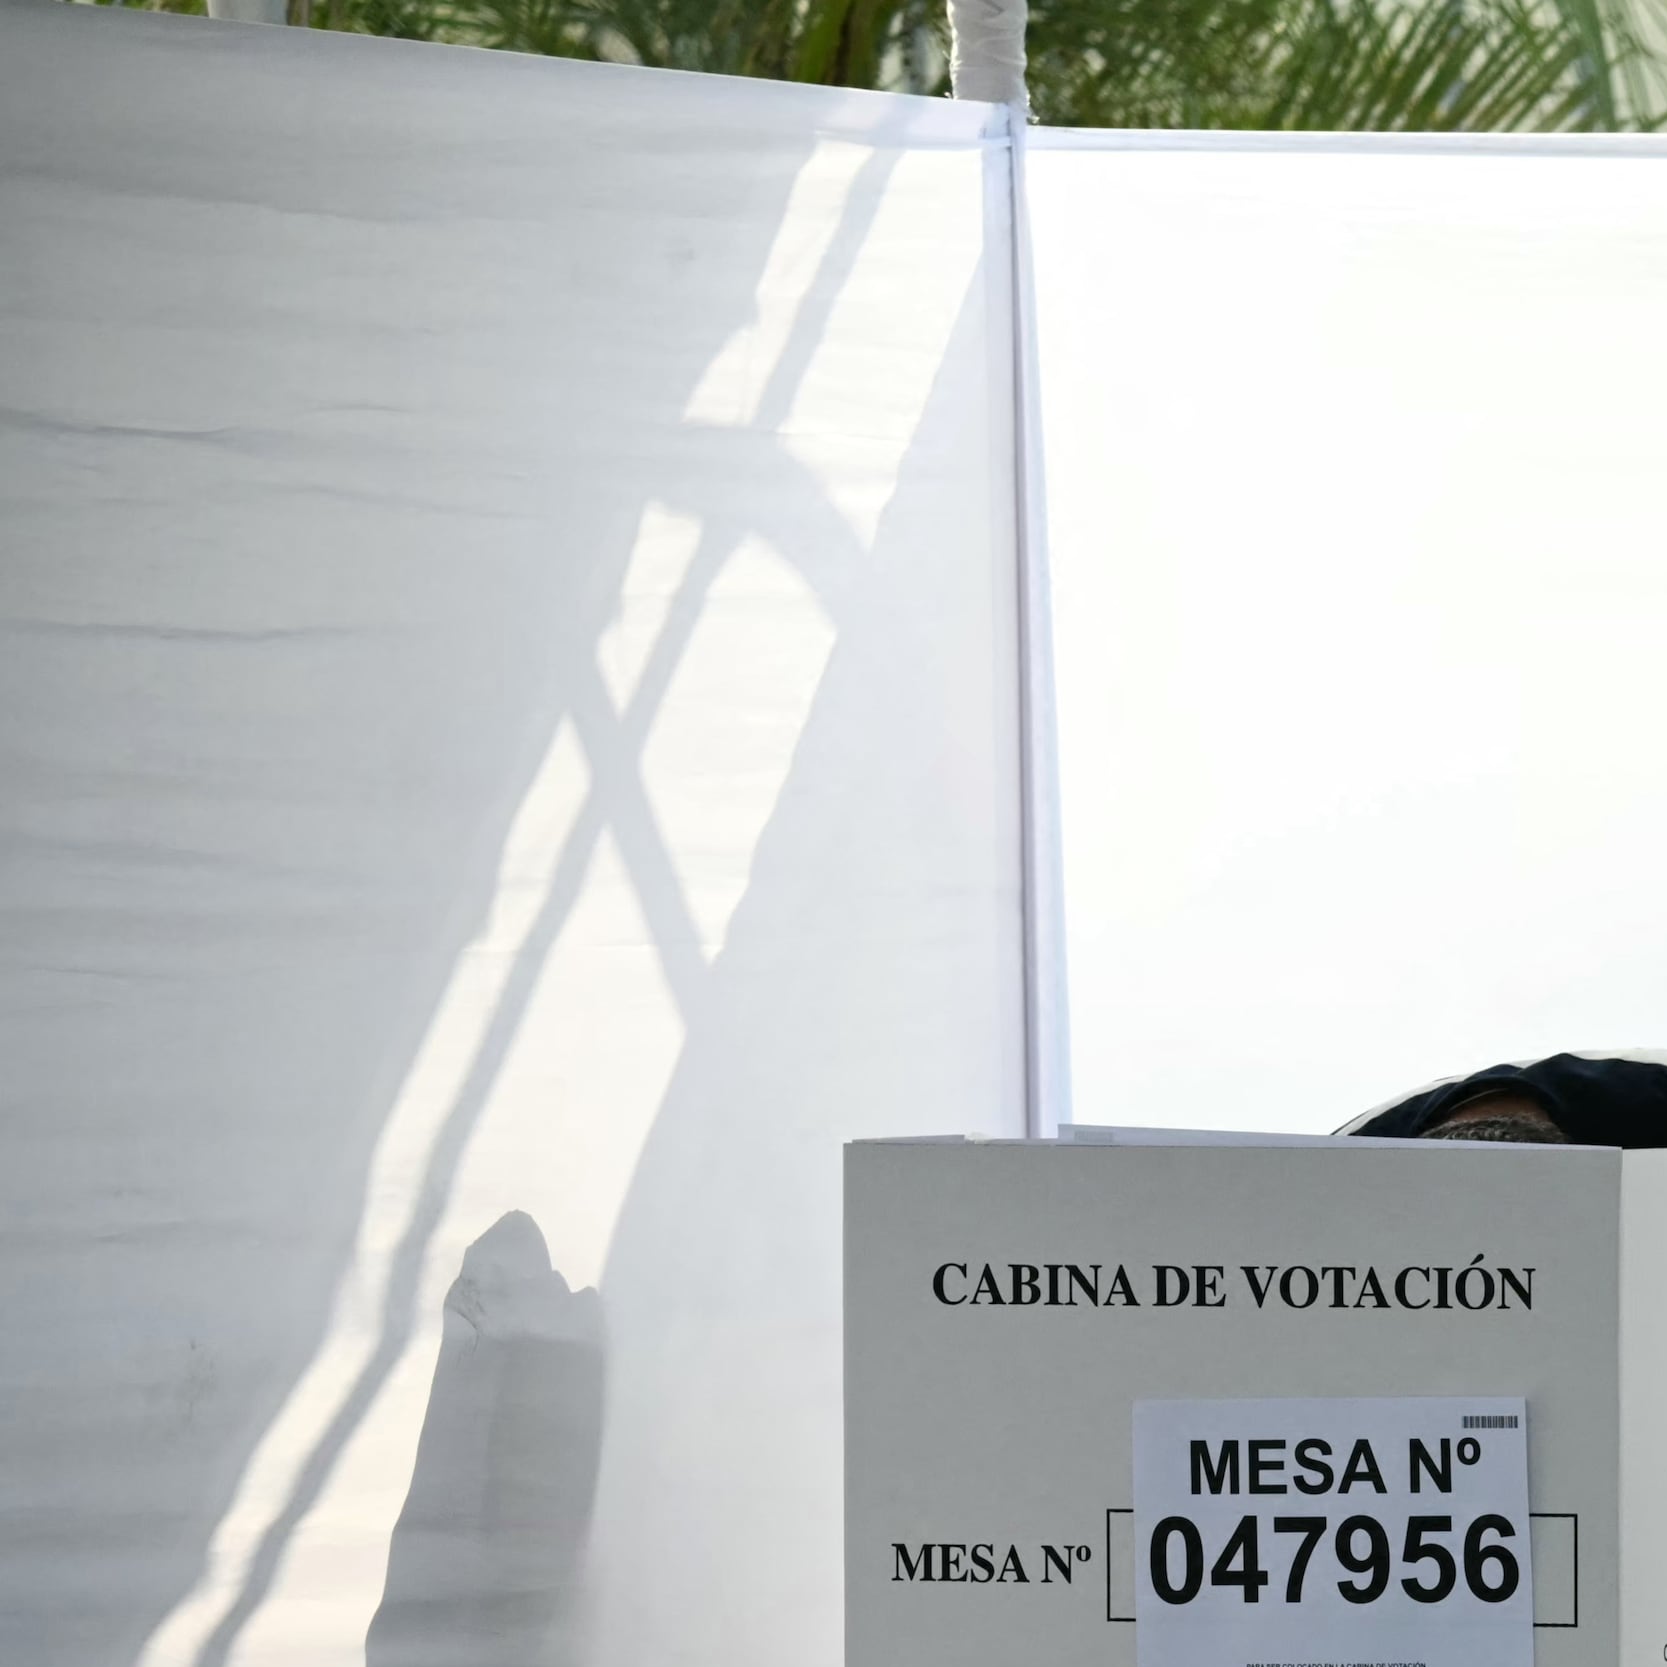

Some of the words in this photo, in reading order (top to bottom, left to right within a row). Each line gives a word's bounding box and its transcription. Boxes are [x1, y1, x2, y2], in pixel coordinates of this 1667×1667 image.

[933, 1263, 1140, 1307] CABINA
[1152, 1266, 1226, 1307] DE
[1240, 1254, 1536, 1310] VOTACIÓN
[1190, 1439, 1387, 1495] MESA
[1410, 1438, 1480, 1493] Nº
[892, 1544, 1030, 1583] MESA
[1041, 1545, 1091, 1584] Nº
[1150, 1514, 1519, 1604] 047956
